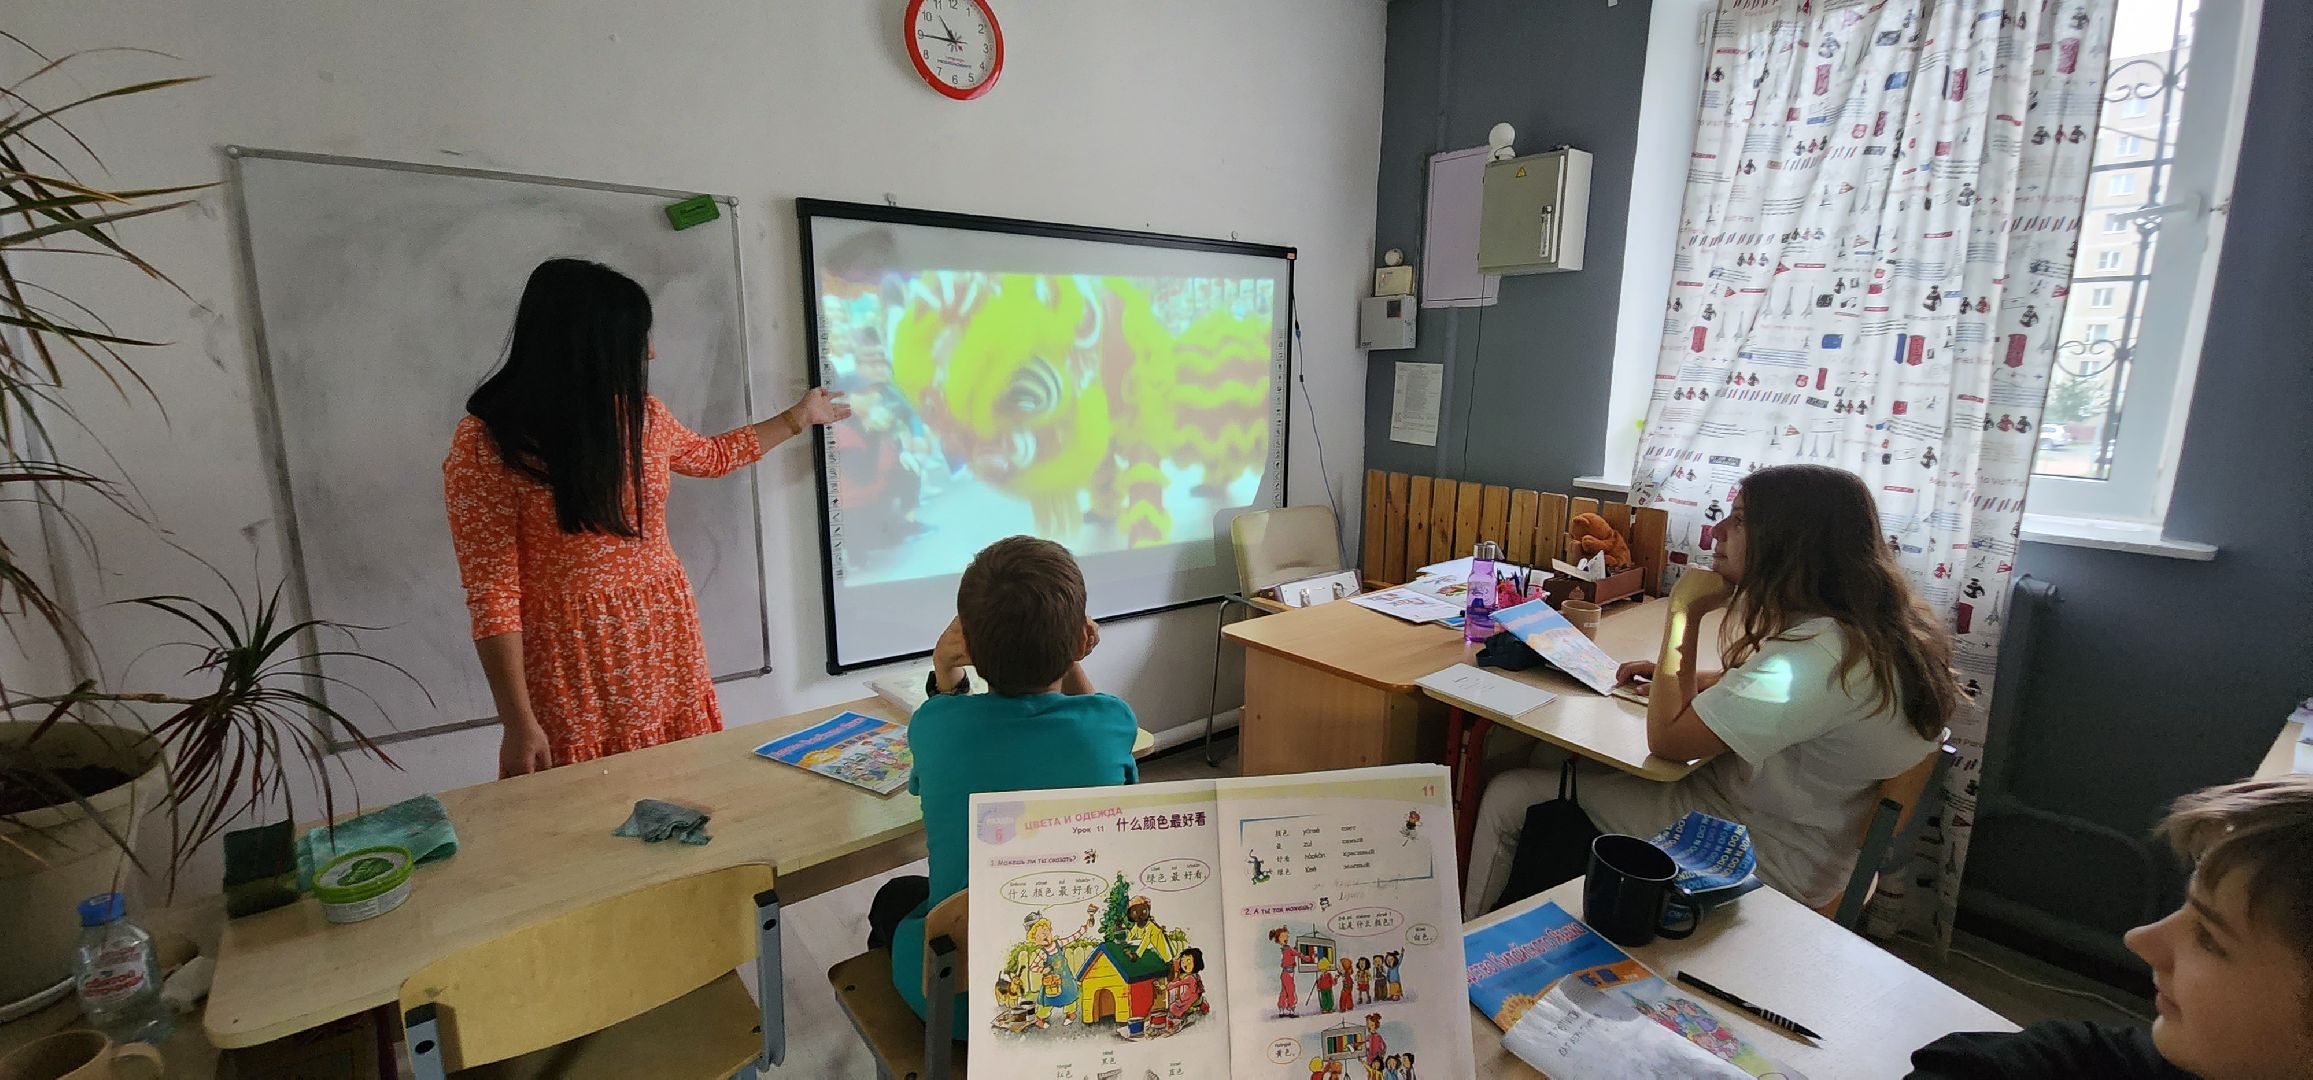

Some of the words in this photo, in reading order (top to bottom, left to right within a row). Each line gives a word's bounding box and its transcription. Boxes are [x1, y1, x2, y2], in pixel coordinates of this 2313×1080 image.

[934, 0, 942, 10] 11
[948, 0, 958, 10] 12
[922, 10, 933, 22] 10
[966, 7, 971, 17] 1
[978, 24, 985, 34] 2
[917, 29, 924, 40] 9
[983, 43, 989, 54] 3
[924, 50, 930, 60] 8
[936, 66, 942, 76] 7
[980, 62, 985, 71] 4
[952, 74, 958, 84] 6
[968, 72, 974, 82] 5
[1424, 784, 1435, 797] 11
[1024, 818, 1061, 831] ЦВЕТА
[1064, 815, 1072, 824] И
[1075, 808, 1122, 822] ОДЕЖДА
[1116, 811, 1206, 832] 什么颜色最好看
[1072, 826, 1092, 835] Урок
